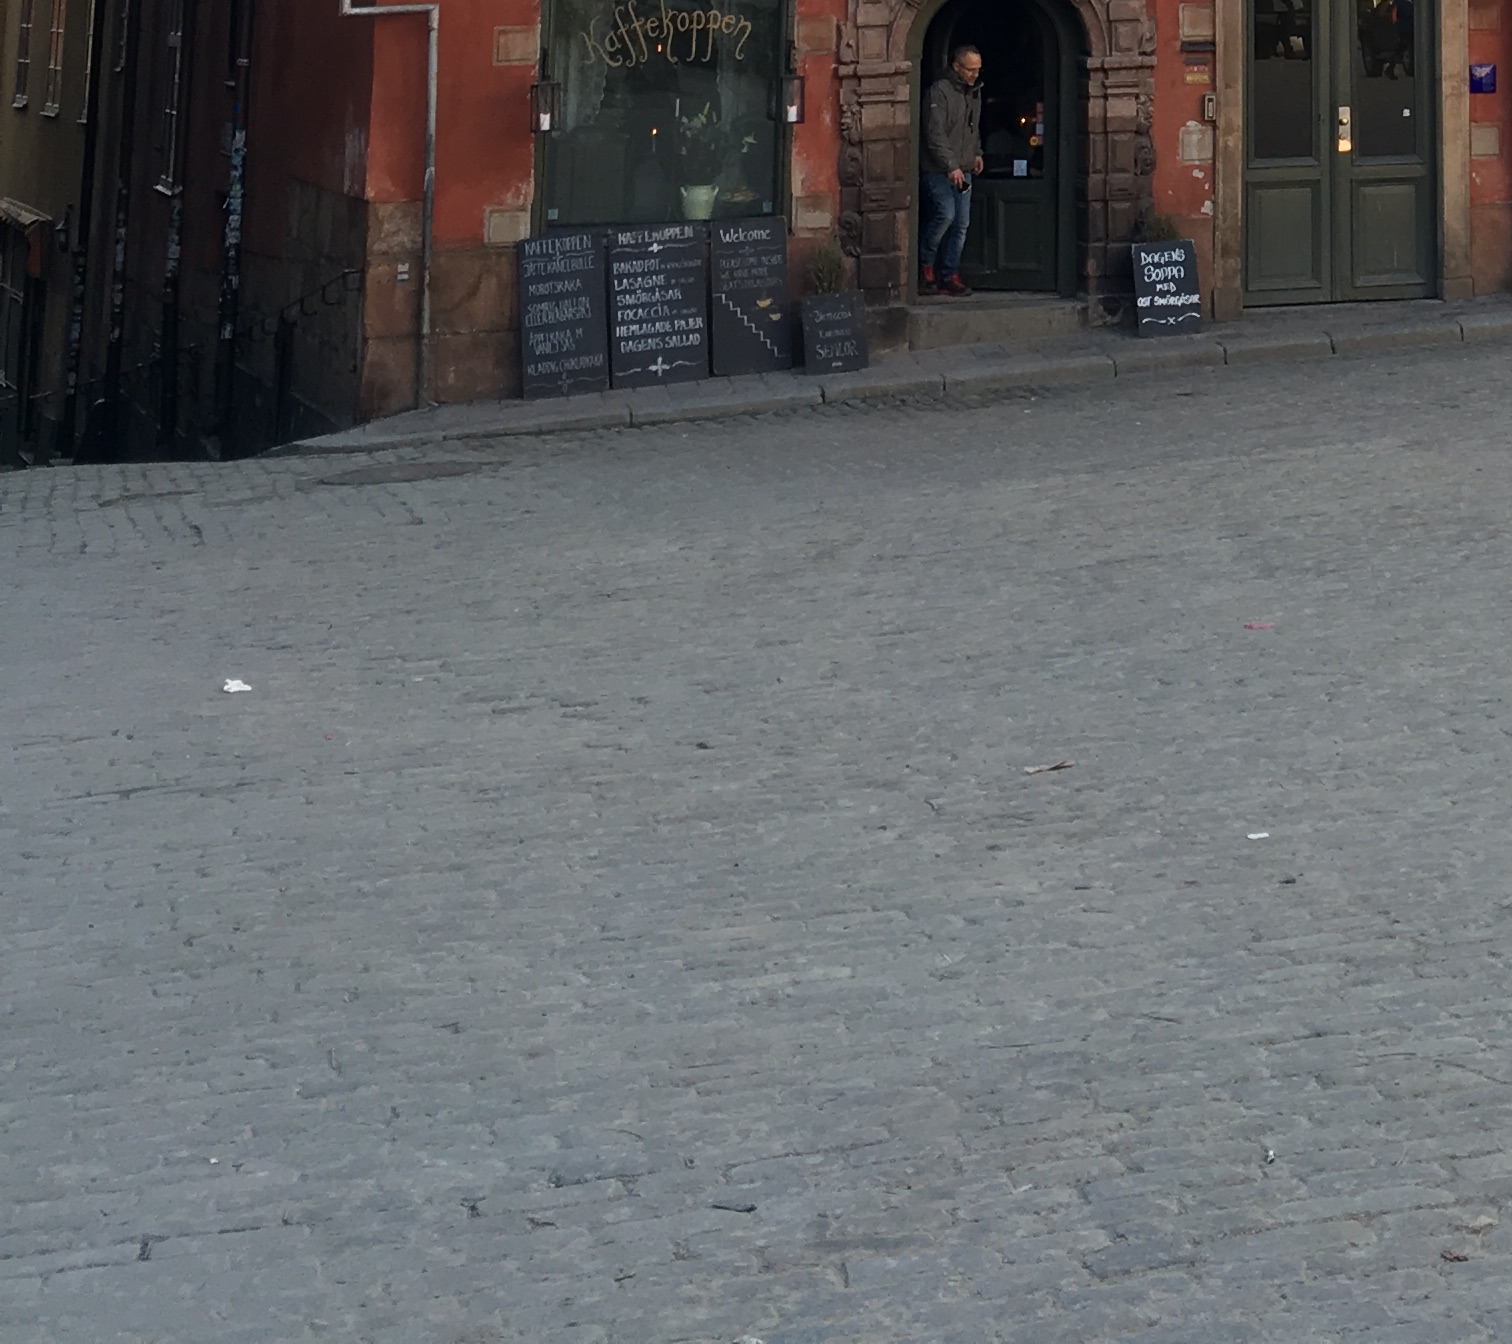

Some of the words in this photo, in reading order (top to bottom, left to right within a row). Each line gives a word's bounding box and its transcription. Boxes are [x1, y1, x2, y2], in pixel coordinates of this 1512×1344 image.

[720, 227, 771, 243] Welcome
[1140, 248, 1186, 266] DAGENS
[614, 274, 666, 291] LASAGNE
[1144, 265, 1185, 283] SOPPA
[1156, 282, 1177, 293] MED
[616, 288, 682, 306] SMÖRGÅSAR
[617, 302, 670, 322] FOCACCIA
[616, 321, 673, 337] HEMLAGADE
[620, 337, 663, 353] DAGENS
[665, 333, 701, 349] SALLAD
